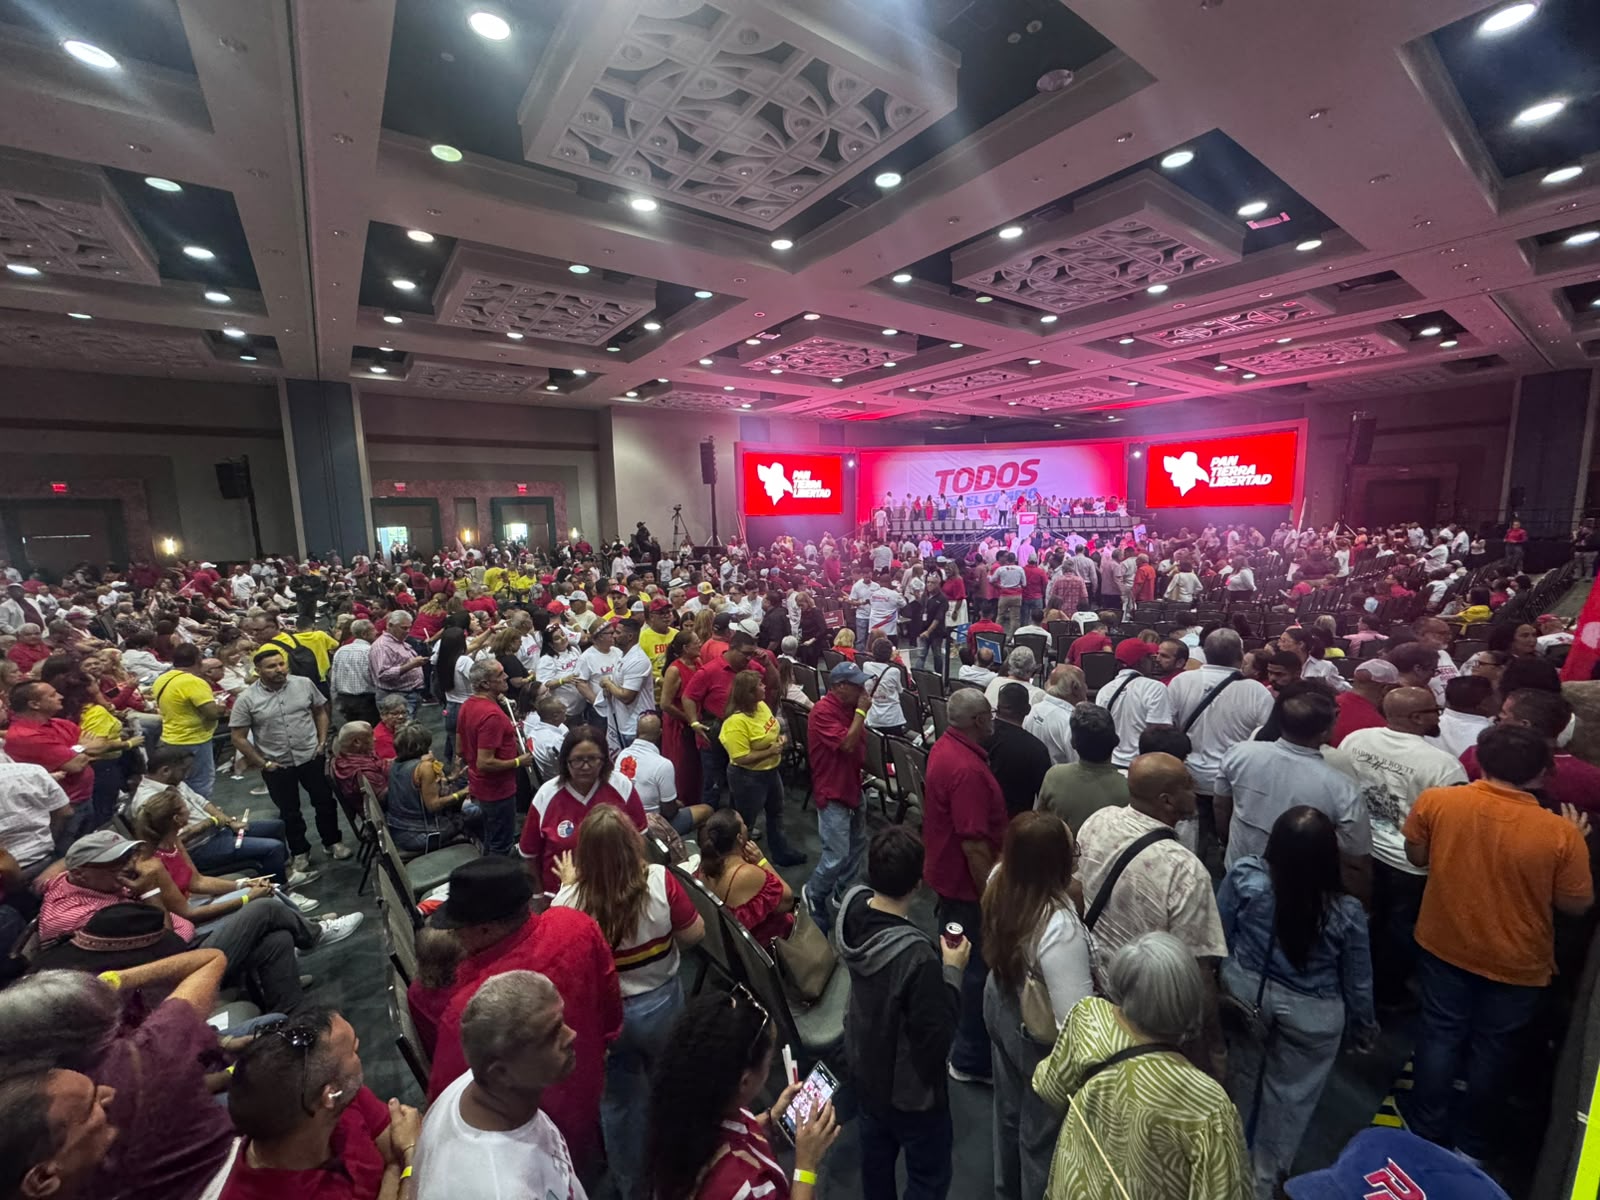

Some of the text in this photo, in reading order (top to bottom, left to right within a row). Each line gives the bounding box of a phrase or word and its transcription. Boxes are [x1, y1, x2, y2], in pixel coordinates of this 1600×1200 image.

[1210, 455, 1239, 467] PAN
[935, 459, 1041, 495] TODOS
[1210, 464, 1256, 477] TIERRA
[1209, 474, 1272, 488] LIBERTAD
